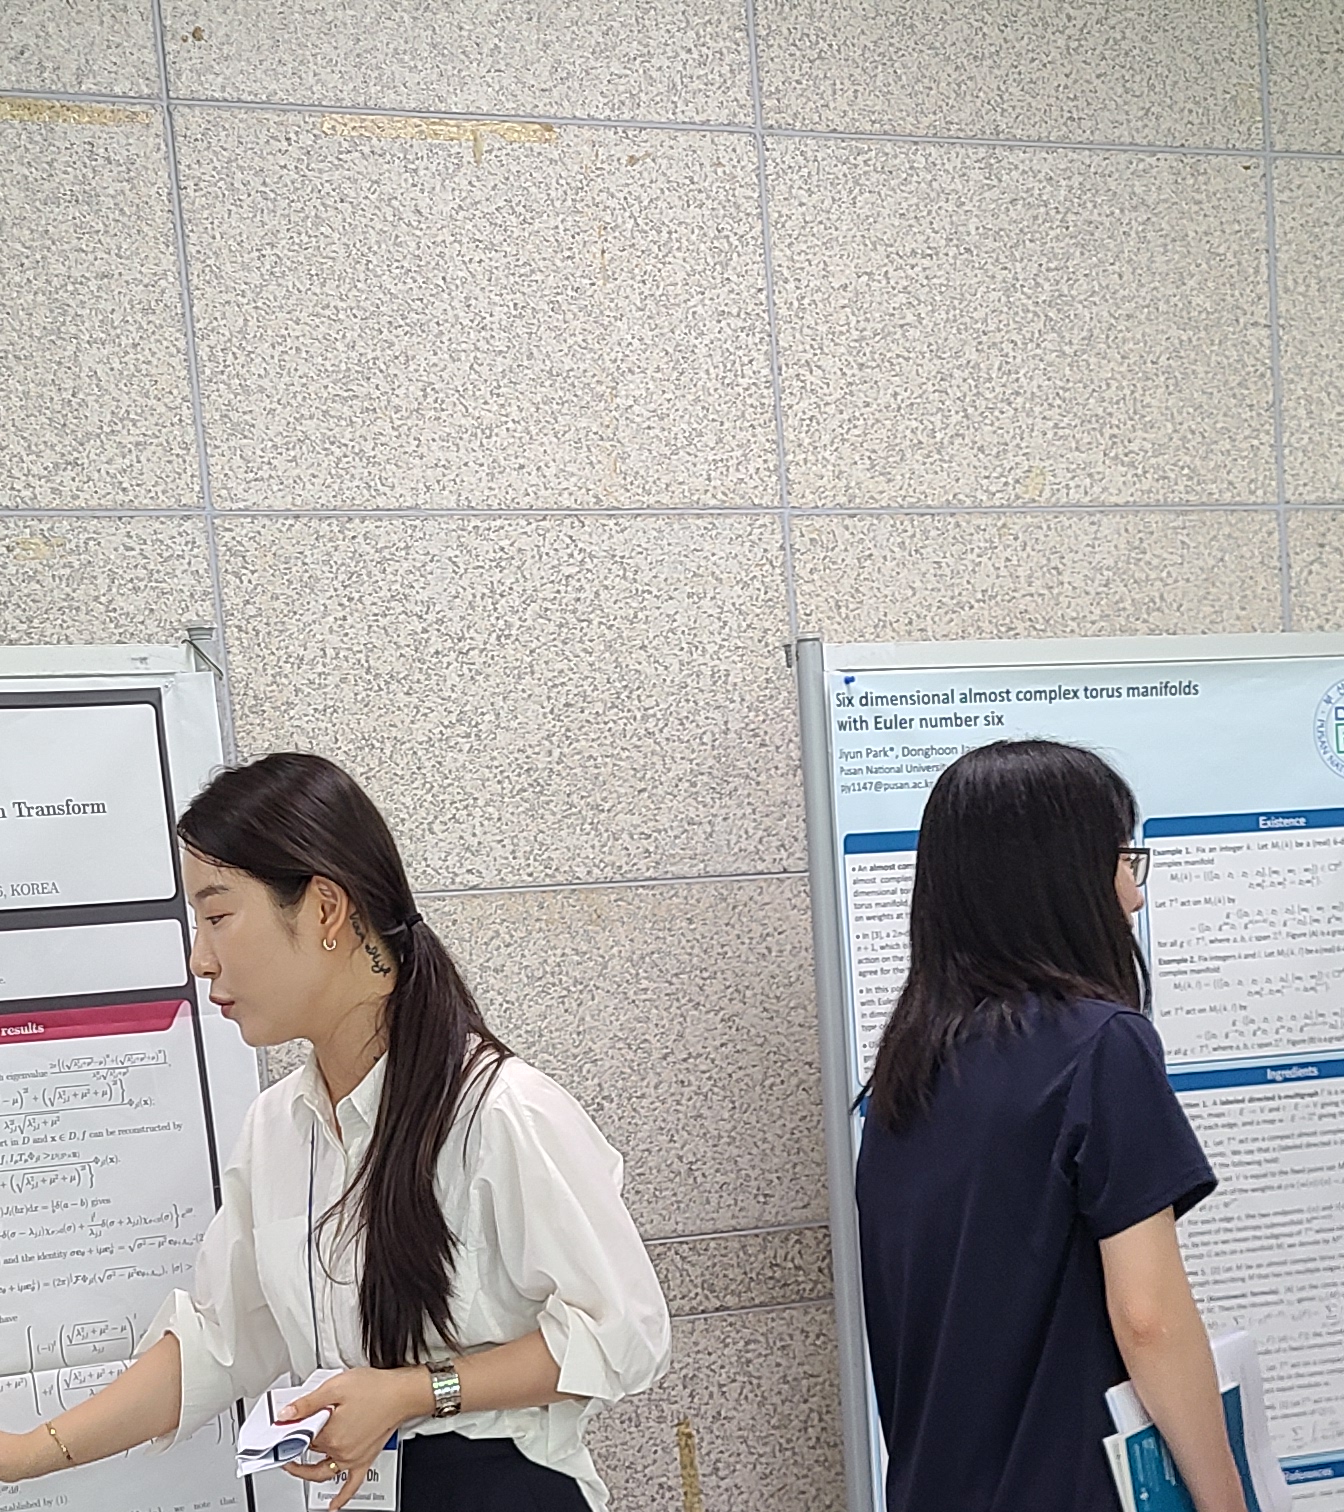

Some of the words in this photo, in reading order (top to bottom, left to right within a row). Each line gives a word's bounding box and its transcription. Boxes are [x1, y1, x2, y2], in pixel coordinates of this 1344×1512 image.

[835, 689, 855, 708] Six
[858, 687, 955, 708] dimensional
[958, 687, 1013, 704] almost
[1015, 683, 1080, 705] complex
[1082, 685, 1123, 700] torus
[1125, 679, 1200, 698] manifolds
[836, 714, 869, 732] with
[873, 713, 915, 731] Euler
[918, 711, 980, 729] number
[983, 710, 1005, 727] six
[838, 747, 863, 762] Jiyun
[900, 744, 959, 759] Donghoon
[839, 765, 864, 776] Pusan
[864, 763, 904, 775] National
[13, 798, 107, 818] Transform
[1258, 815, 1307, 829] Existence
[10, 881, 59, 897] KOREA
[0, 1022, 45, 1037] results
